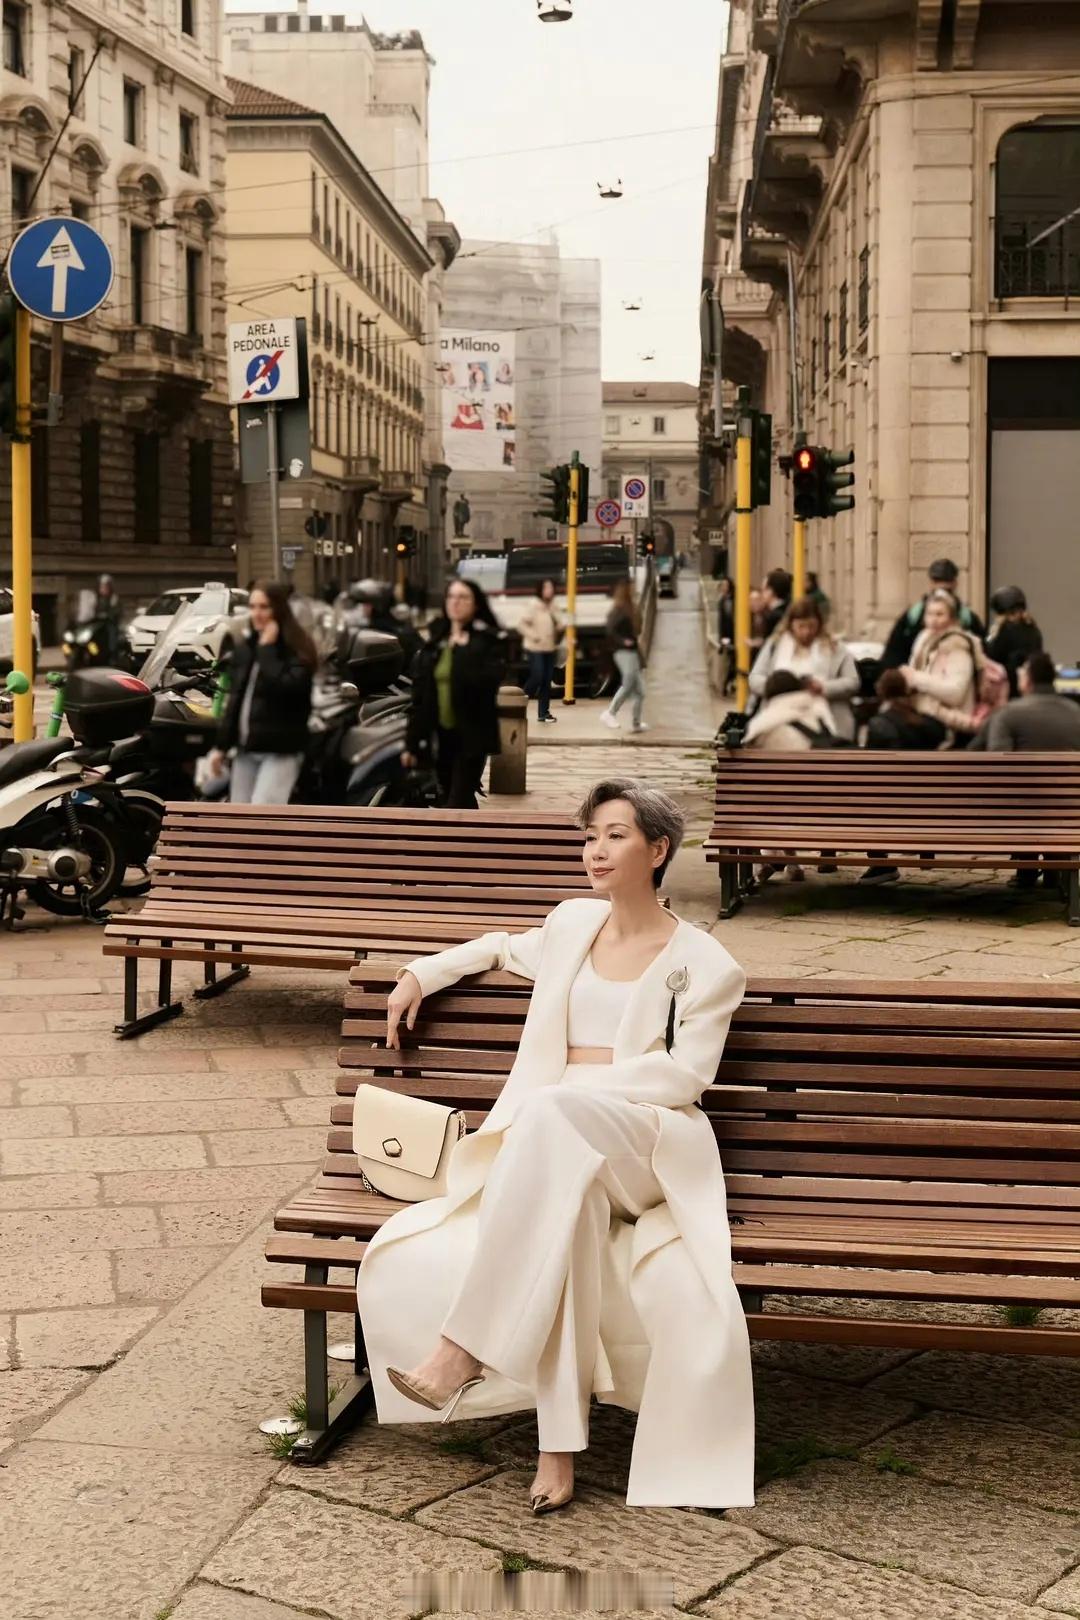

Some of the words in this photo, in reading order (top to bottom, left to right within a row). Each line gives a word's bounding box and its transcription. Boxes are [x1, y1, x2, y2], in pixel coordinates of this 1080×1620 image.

[247, 323, 276, 335] AREA
[233, 336, 291, 352] PEDONALE
[452, 337, 500, 352] Milano
